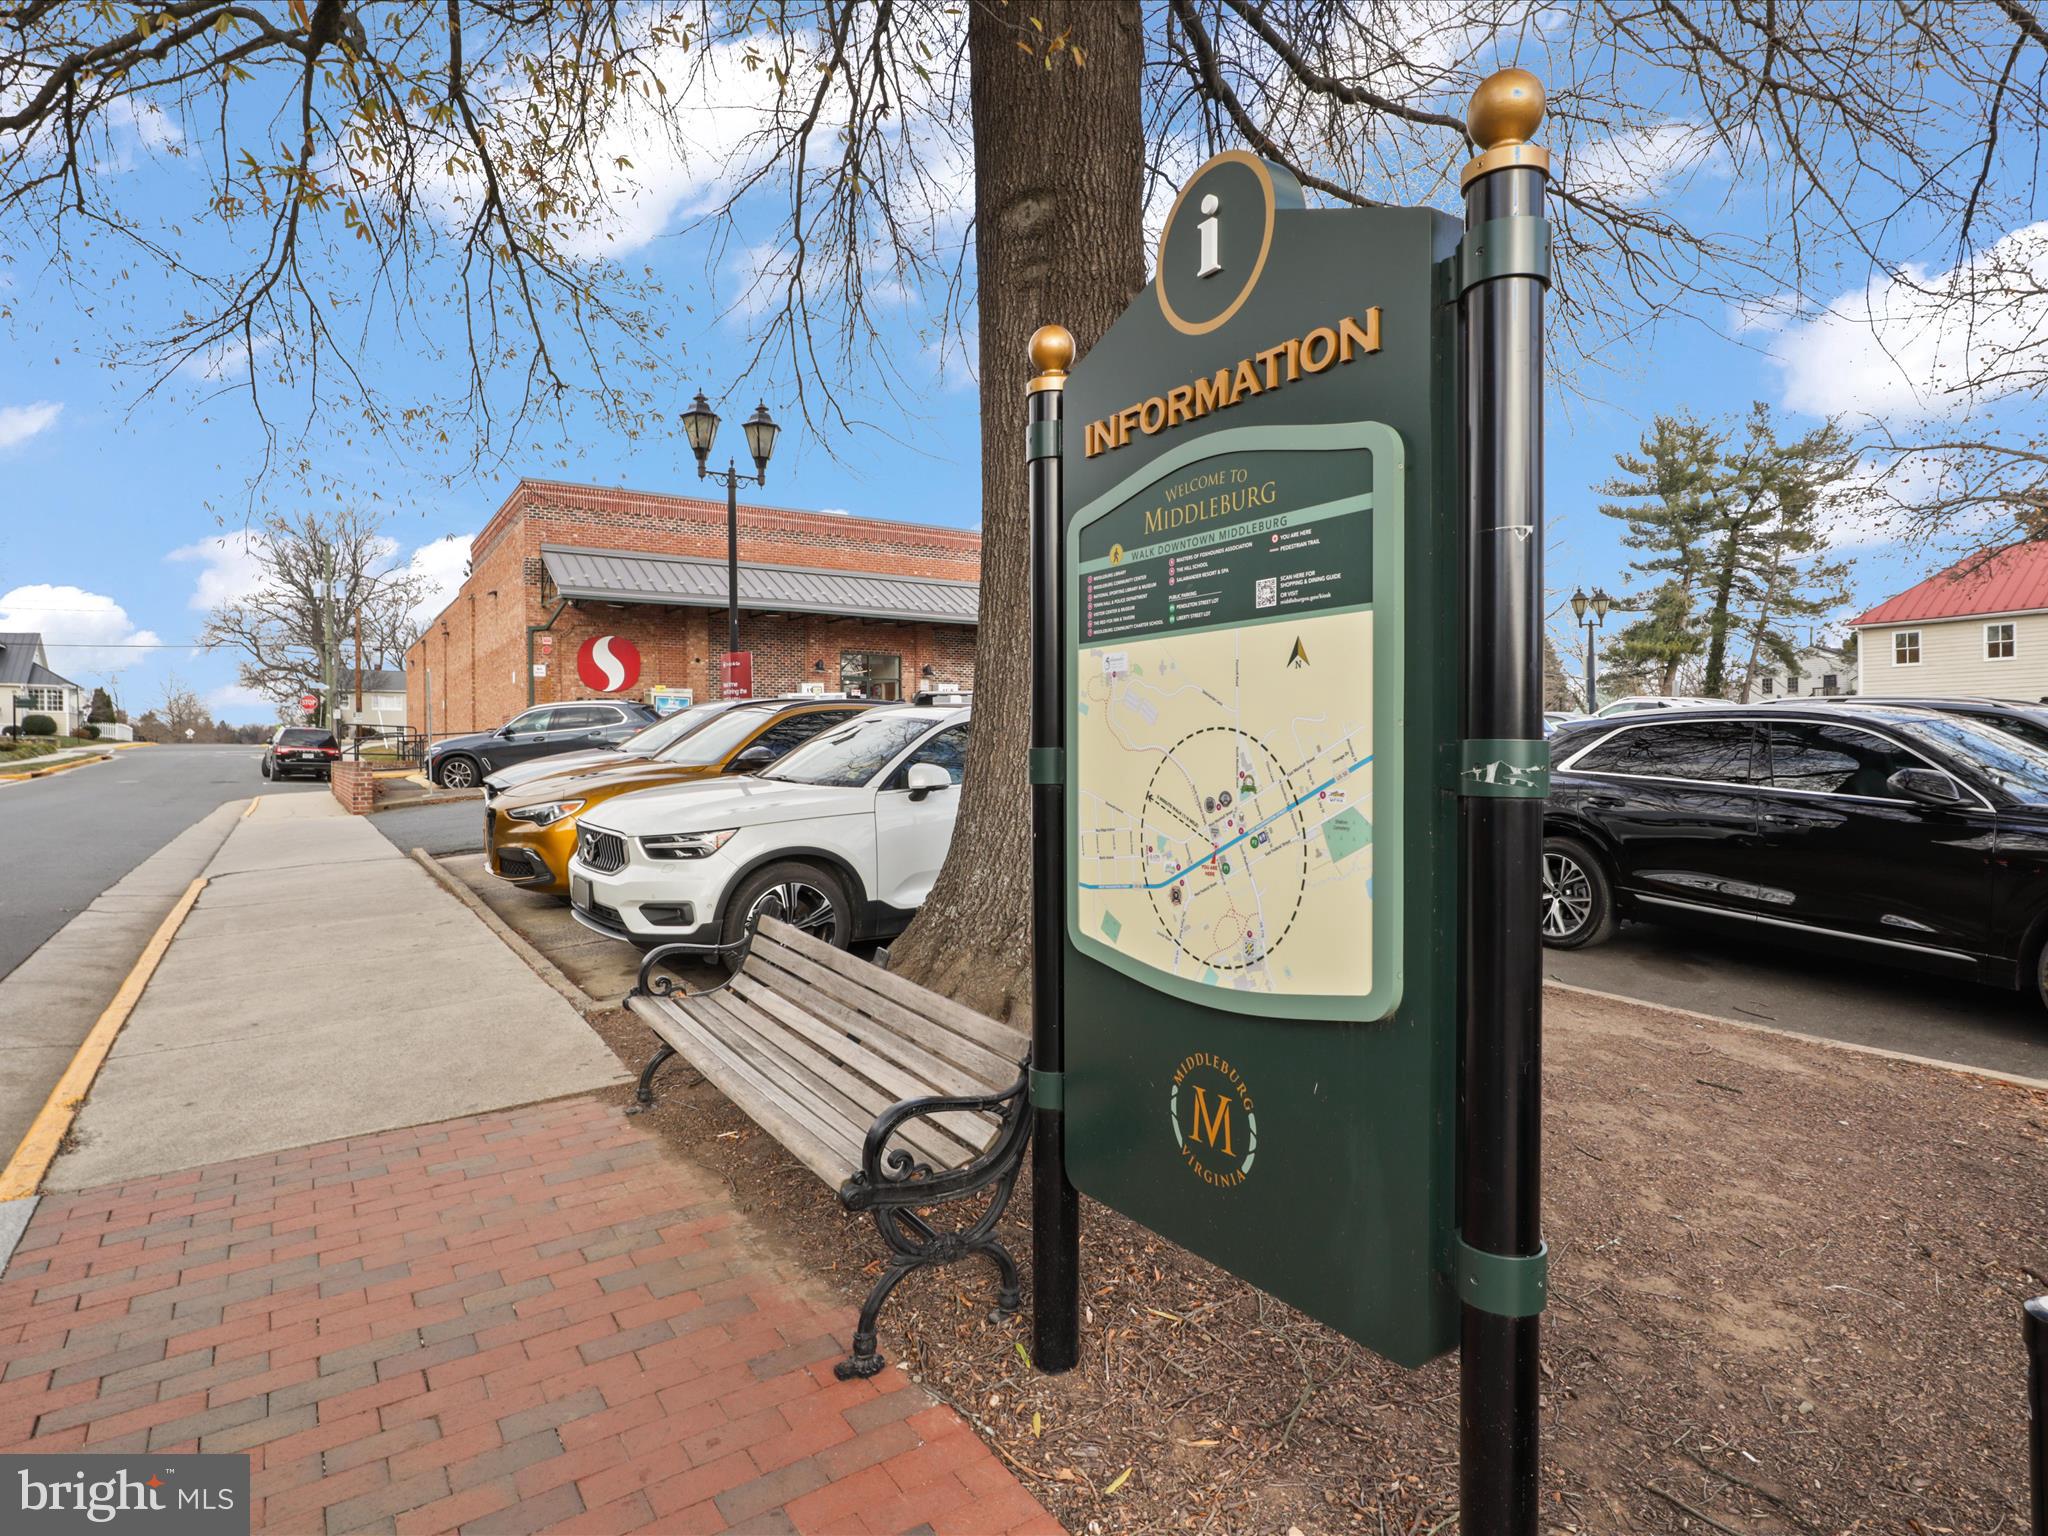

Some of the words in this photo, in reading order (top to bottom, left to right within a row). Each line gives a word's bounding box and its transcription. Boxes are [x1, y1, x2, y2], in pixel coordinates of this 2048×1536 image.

[1197, 194, 1222, 278] i
[1084, 305, 1383, 458] INFORMATION
[1166, 471, 1226, 502] WELCOME
[1230, 469, 1248, 483] TO
[1144, 481, 1277, 535] MIDDLEBURG
[1131, 547, 1155, 561] WALK
[1158, 534, 1215, 553] DOWNTOWN
[1219, 516, 1288, 541] MIDDLEBURG
[1225, 542, 1252, 552] ASSOCIATION
[1280, 542, 1307, 551] PEDESTRIAN
[1280, 580, 1303, 588] SHOPPING
[1295, 660, 1302, 669] N
[1172, 1053, 1253, 1111] MIDDLEBURG
[1188, 1085, 1237, 1157] M
[1182, 1144, 1246, 1187] VIRGINIA
